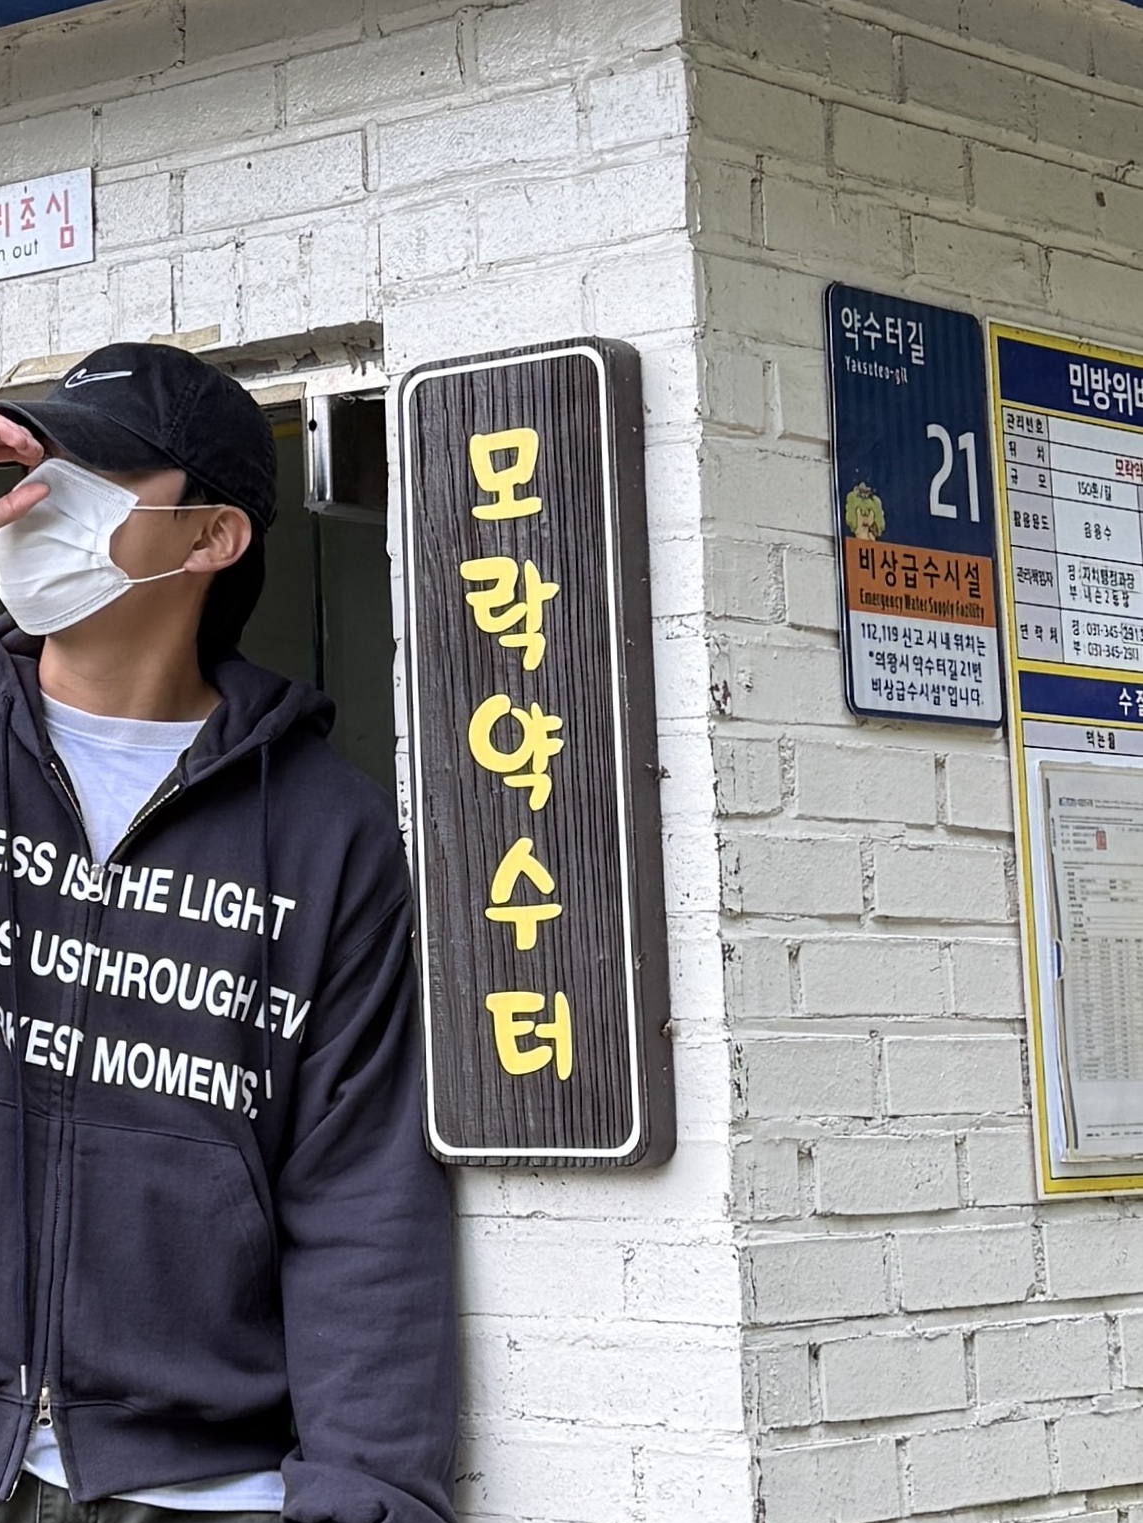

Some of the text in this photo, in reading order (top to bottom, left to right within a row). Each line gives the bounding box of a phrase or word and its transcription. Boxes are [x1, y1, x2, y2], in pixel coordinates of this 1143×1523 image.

[12, 239, 39, 260] out
[841, 307, 925, 365] 약수터길
[844, 355, 908, 385] Yaksuteo-gil
[1007, 413, 1044, 434] 관리번호
[926, 423, 980, 522] 21
[859, 547, 981, 599] 비상급수시설
[860, 588, 985, 623] Emergency Water Supply Facility
[861, 622, 899, 643] 112,119
[912, 654, 958, 681] 약수터길
[960, 661, 983, 683] 21번
[460, 427, 573, 1081] 모락약수터
[102, 863, 174, 914] THE
[179, 873, 296, 941] LIGHT
[30, 930, 82, 983] US
[80, 942, 258, 1023] THROUGH
[91, 1036, 258, 1120] MOMENS.
